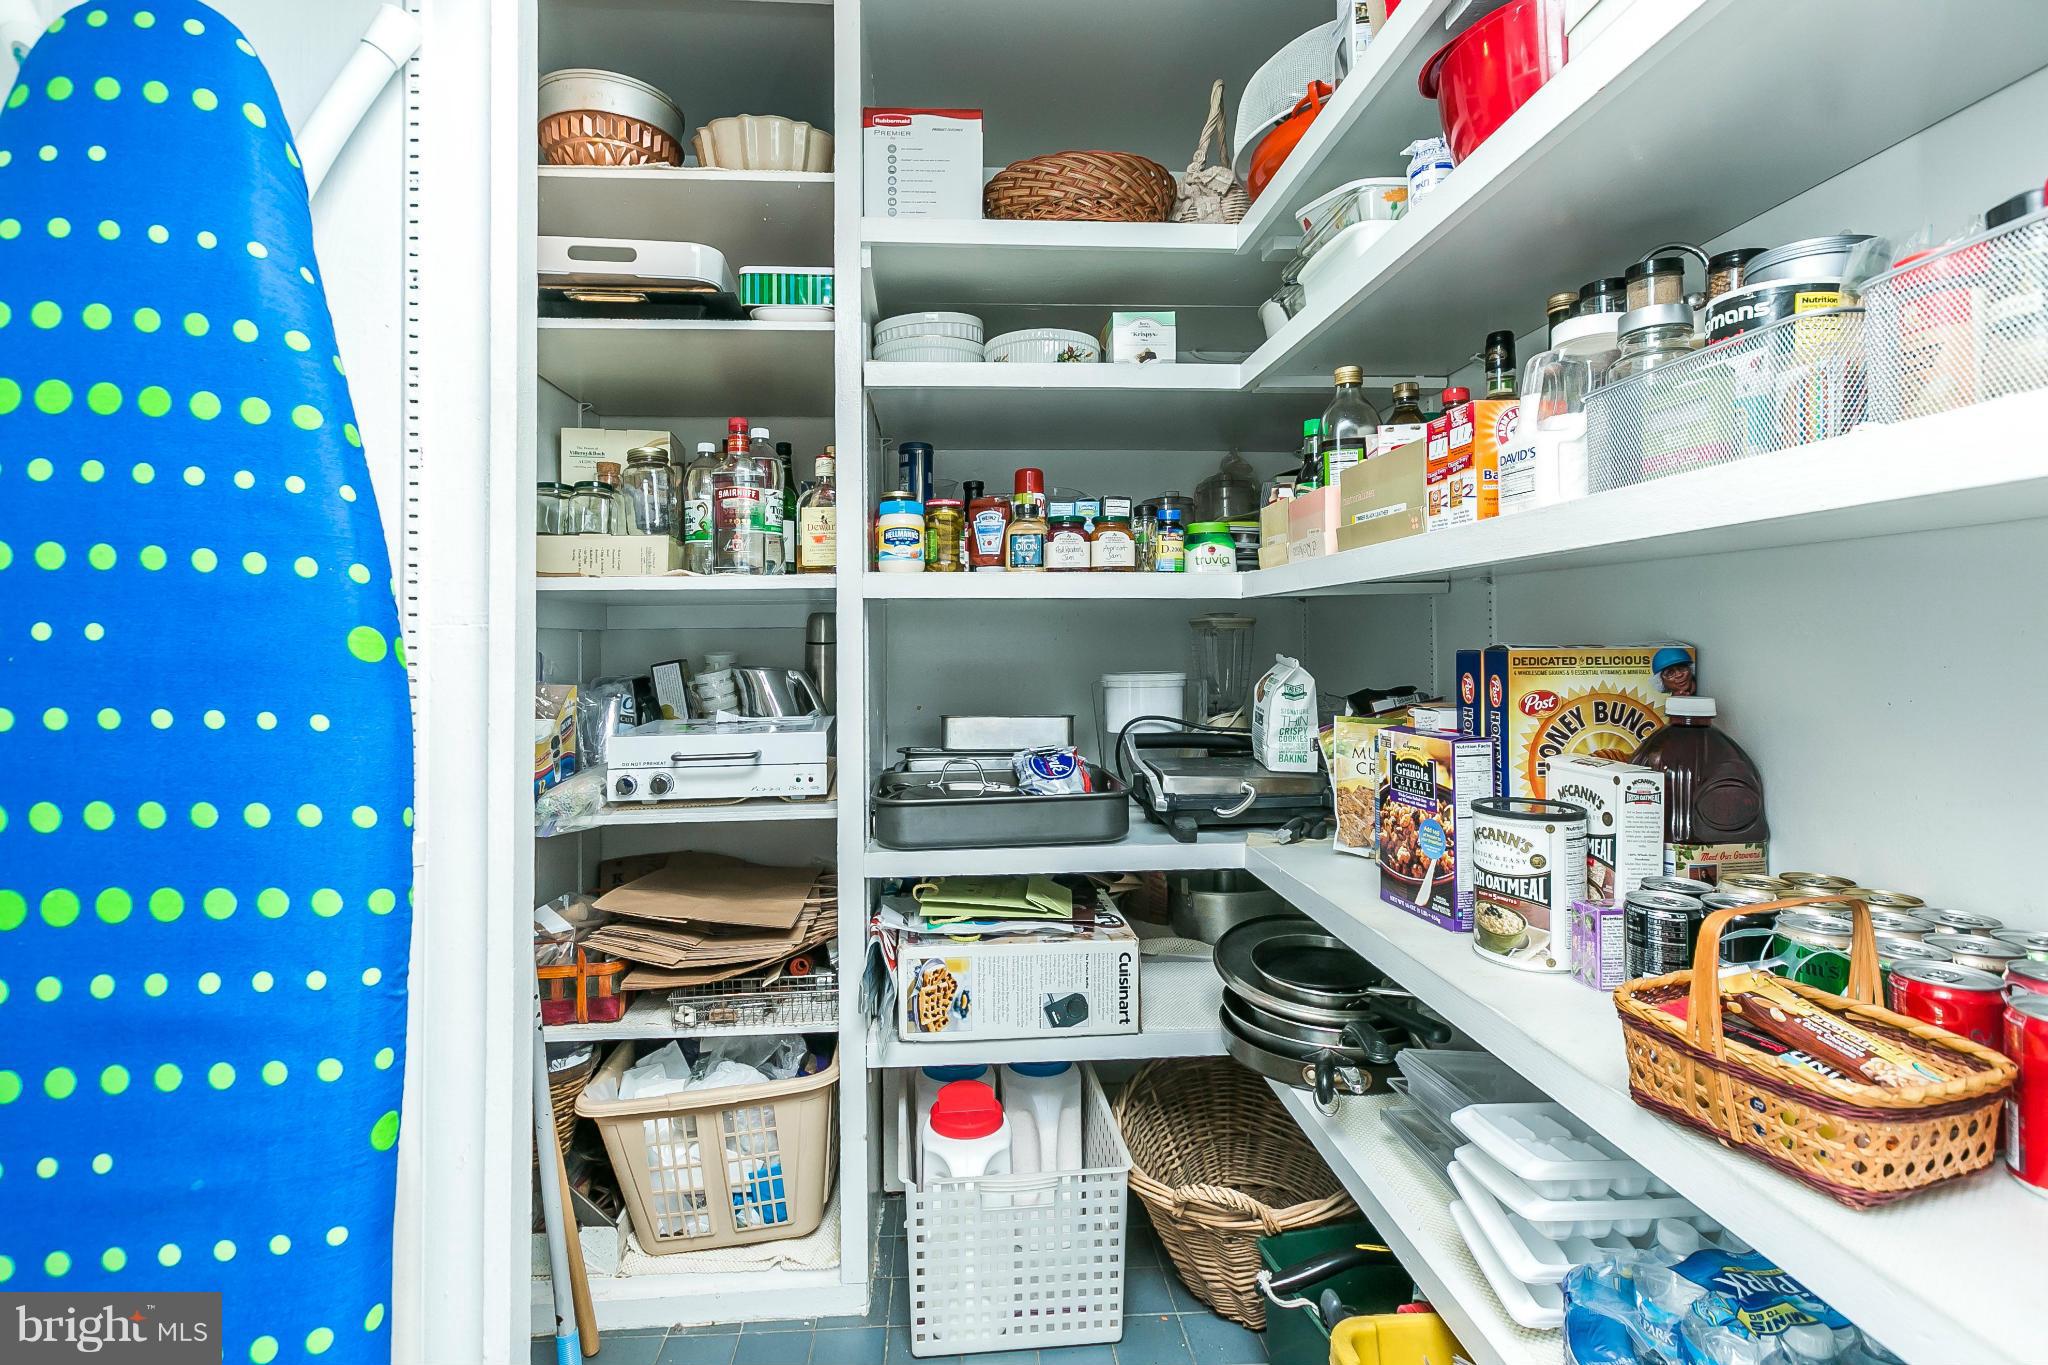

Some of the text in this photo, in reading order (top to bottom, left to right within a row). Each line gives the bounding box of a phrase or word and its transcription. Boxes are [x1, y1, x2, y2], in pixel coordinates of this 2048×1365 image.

[1500, 447, 1536, 466] DAVID'S
[1015, 543, 1038, 551] DIJON
[1195, 554, 1231, 567] truvia
[1513, 656, 1577, 666] DEDICATED
[1586, 655, 1650, 665] DELICIOUS
[1464, 678, 1474, 700] Post
[1491, 679, 1501, 703] Post
[1524, 693, 1557, 714] Post
[1282, 715, 1309, 728] THIN
[1278, 735, 1308, 743] COOKIES
[1279, 727, 1308, 736] CRISPY
[1278, 754, 1307, 763] BAKING
[1396, 763, 1429, 781] Granola
[1394, 776, 1431, 791] CEREAL
[1503, 856, 1527, 865] EASY
[1486, 874, 1548, 906] OATMEAL
[1117, 951, 1132, 1025] Cuisinart
[1712, 1273, 1802, 1299] PARK
[1750, 1311, 1809, 1332] MINIS
